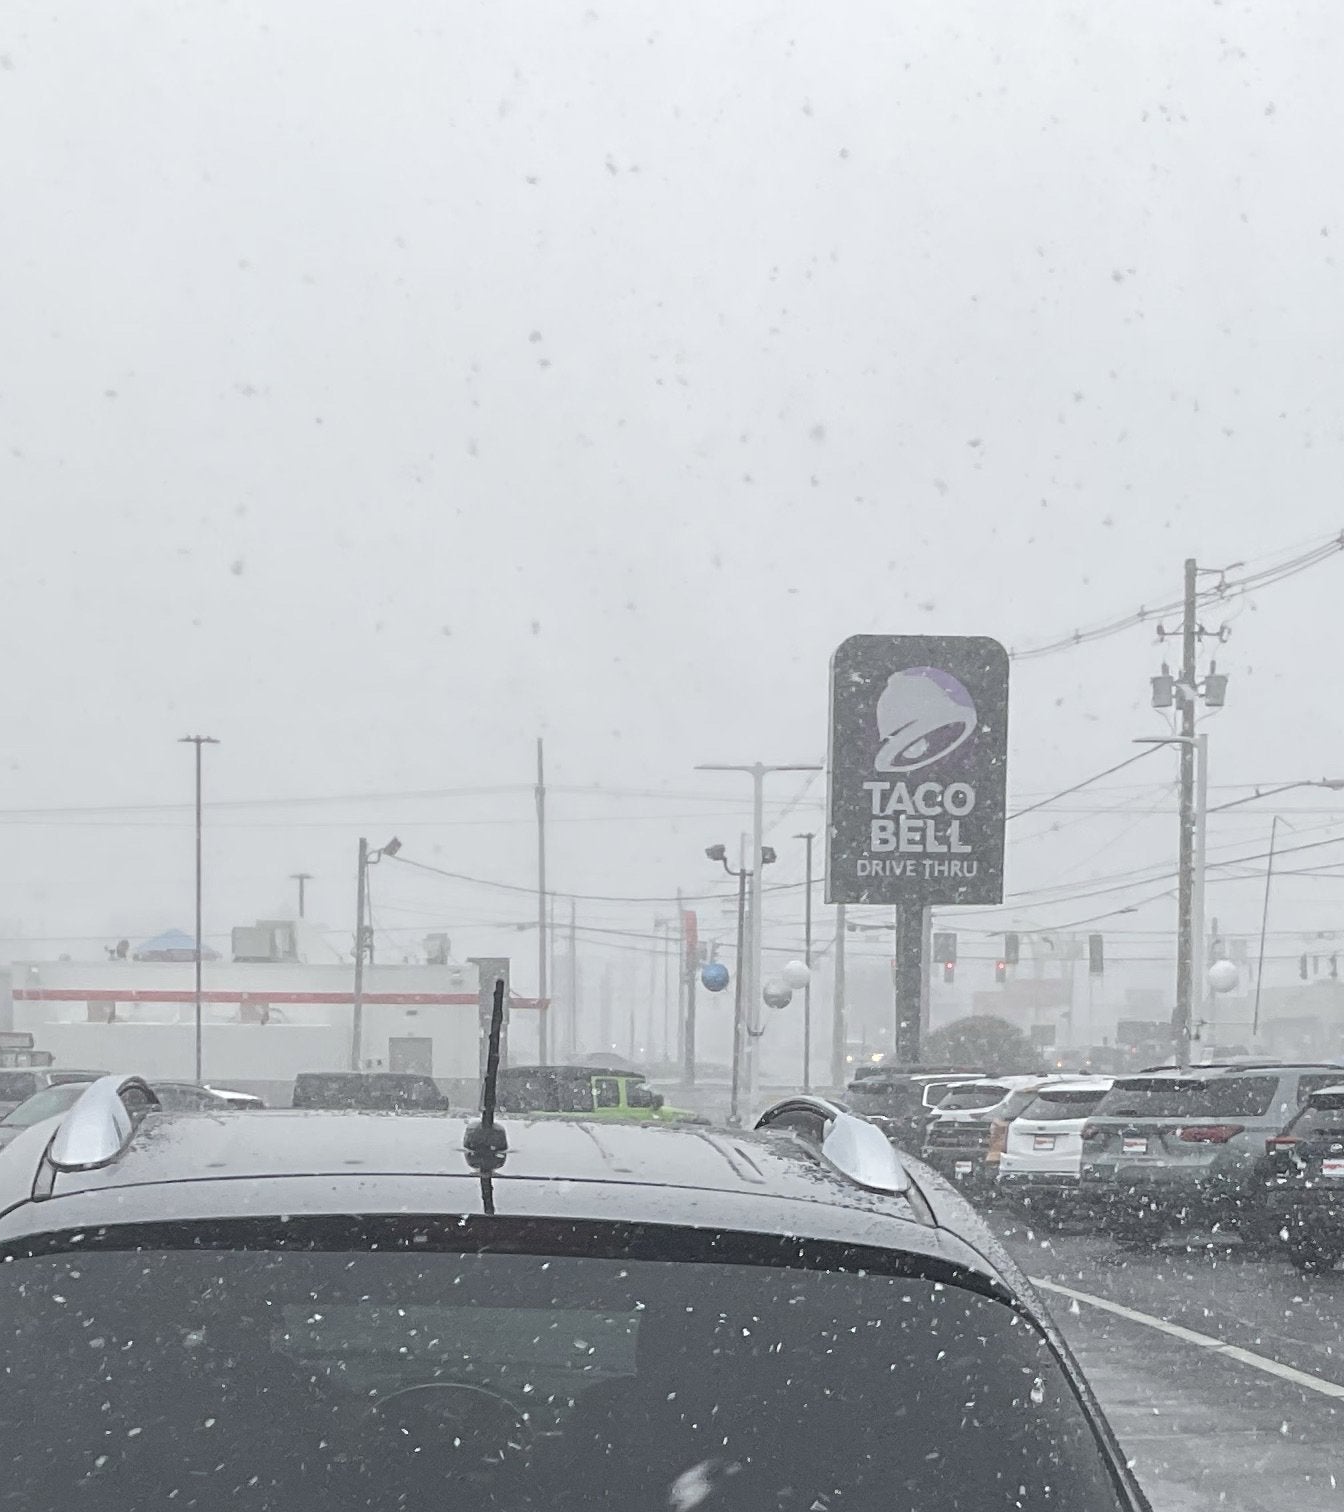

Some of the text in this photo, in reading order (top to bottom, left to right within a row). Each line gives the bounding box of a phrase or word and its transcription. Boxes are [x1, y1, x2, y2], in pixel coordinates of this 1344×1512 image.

[862, 781, 976, 816] TACO
[870, 817, 972, 853] BELL
[856, 859, 977, 878] DRIVE THRU
